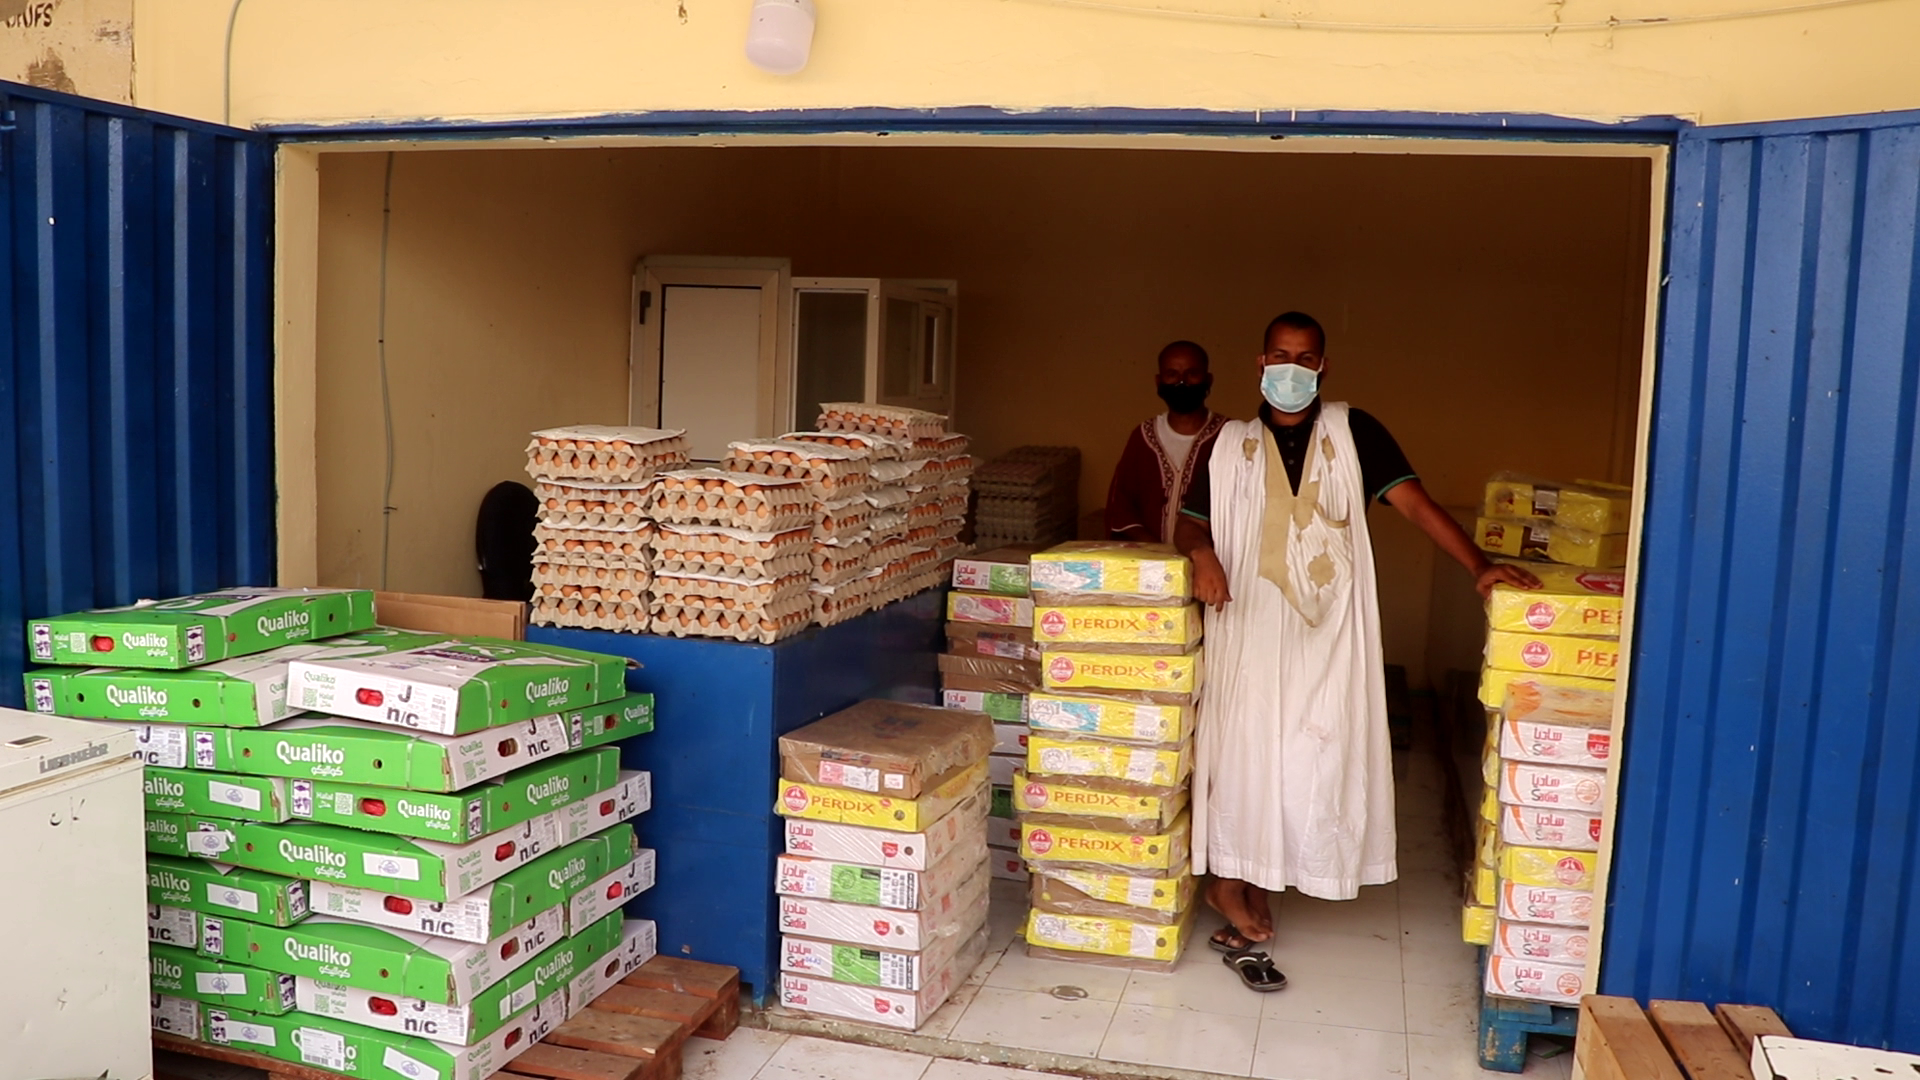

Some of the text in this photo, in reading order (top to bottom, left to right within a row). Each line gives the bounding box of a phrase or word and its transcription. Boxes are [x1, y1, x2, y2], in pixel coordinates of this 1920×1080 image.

[257, 609, 309, 637] Qualiko
[1072, 618, 1140, 631] PERDIX
[122, 632, 168, 649] Qualiko
[1081, 664, 1150, 679] PERDIX
[106, 684, 168, 707] Qualiko
[525, 676, 570, 703] Qualiko
[276, 740, 345, 765] Qualiko
[145, 777, 184, 797] aliko
[527, 775, 570, 805] Qualiko
[398, 799, 452, 819] Qualiko
[811, 795, 876, 815] PERDIX
[1054, 791, 1120, 808] PERDIX
[279, 838, 346, 868] Qualiko
[1058, 837, 1125, 854] PERDIX
[548, 857, 586, 890] Qualiko
[284, 937, 352, 967] Qualiko
[535, 948, 574, 986] Qualiko
